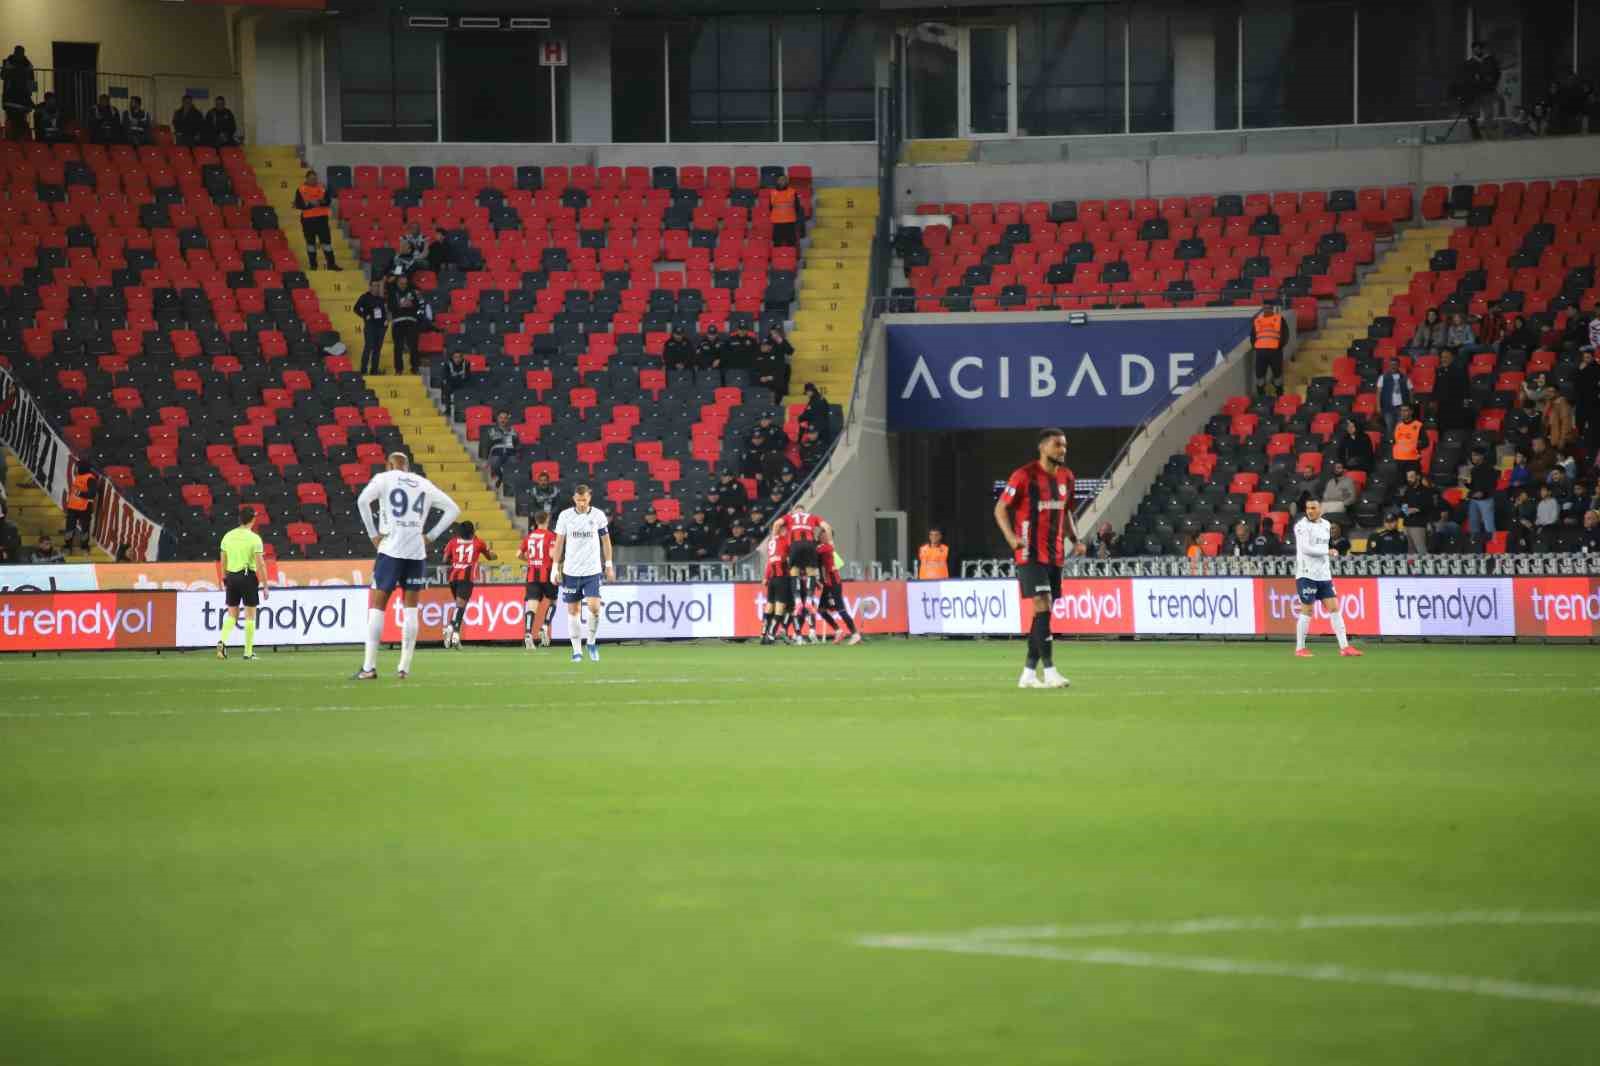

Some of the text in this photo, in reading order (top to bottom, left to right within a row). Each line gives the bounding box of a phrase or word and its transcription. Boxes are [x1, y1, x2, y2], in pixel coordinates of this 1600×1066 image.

[901, 350, 1227, 399] ACIBADE
[389, 487, 426, 520] 94
[791, 512, 810, 525] 17
[455, 545, 474, 563] 11
[528, 539, 544, 560] 51
[0, 601, 153, 640] trendyol
[393, 595, 527, 632] tendyo
[581, 592, 712, 629] tendyol
[921, 589, 1007, 624] trendyol
[1052, 588, 1122, 624] endyol
[1148, 587, 1239, 625] trendyol
[1396, 587, 1498, 627] trendyol
